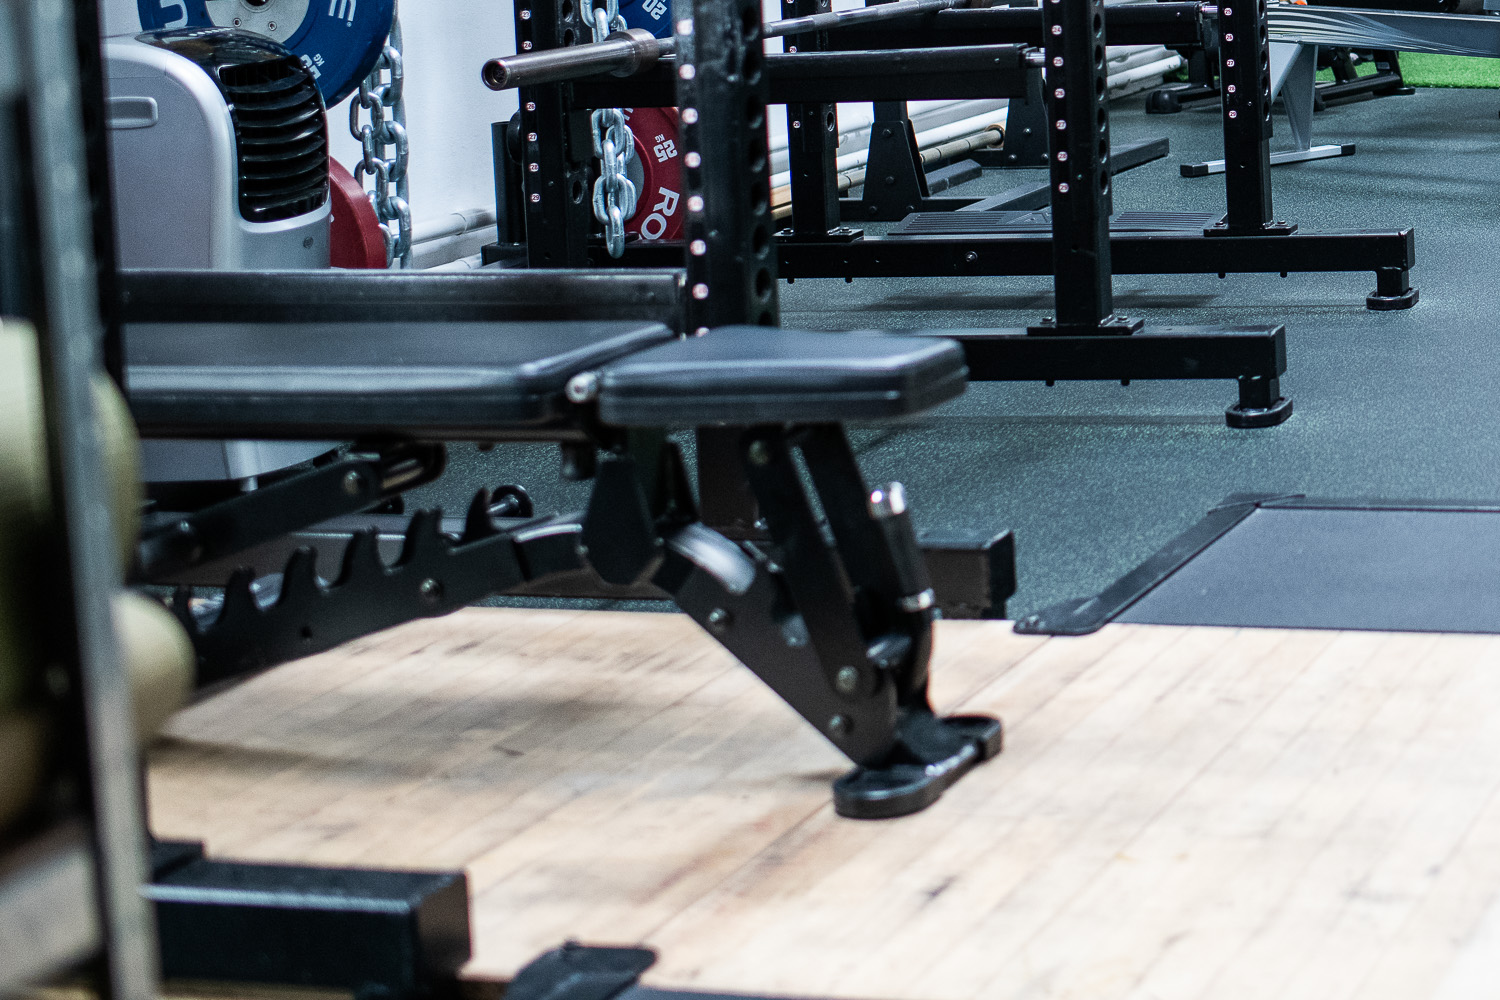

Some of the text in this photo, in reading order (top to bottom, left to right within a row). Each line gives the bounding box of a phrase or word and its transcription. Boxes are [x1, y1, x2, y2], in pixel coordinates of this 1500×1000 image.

[312, 53, 325, 67] KG
[655, 133, 665, 143] KG
[653, 140, 678, 162] 25
